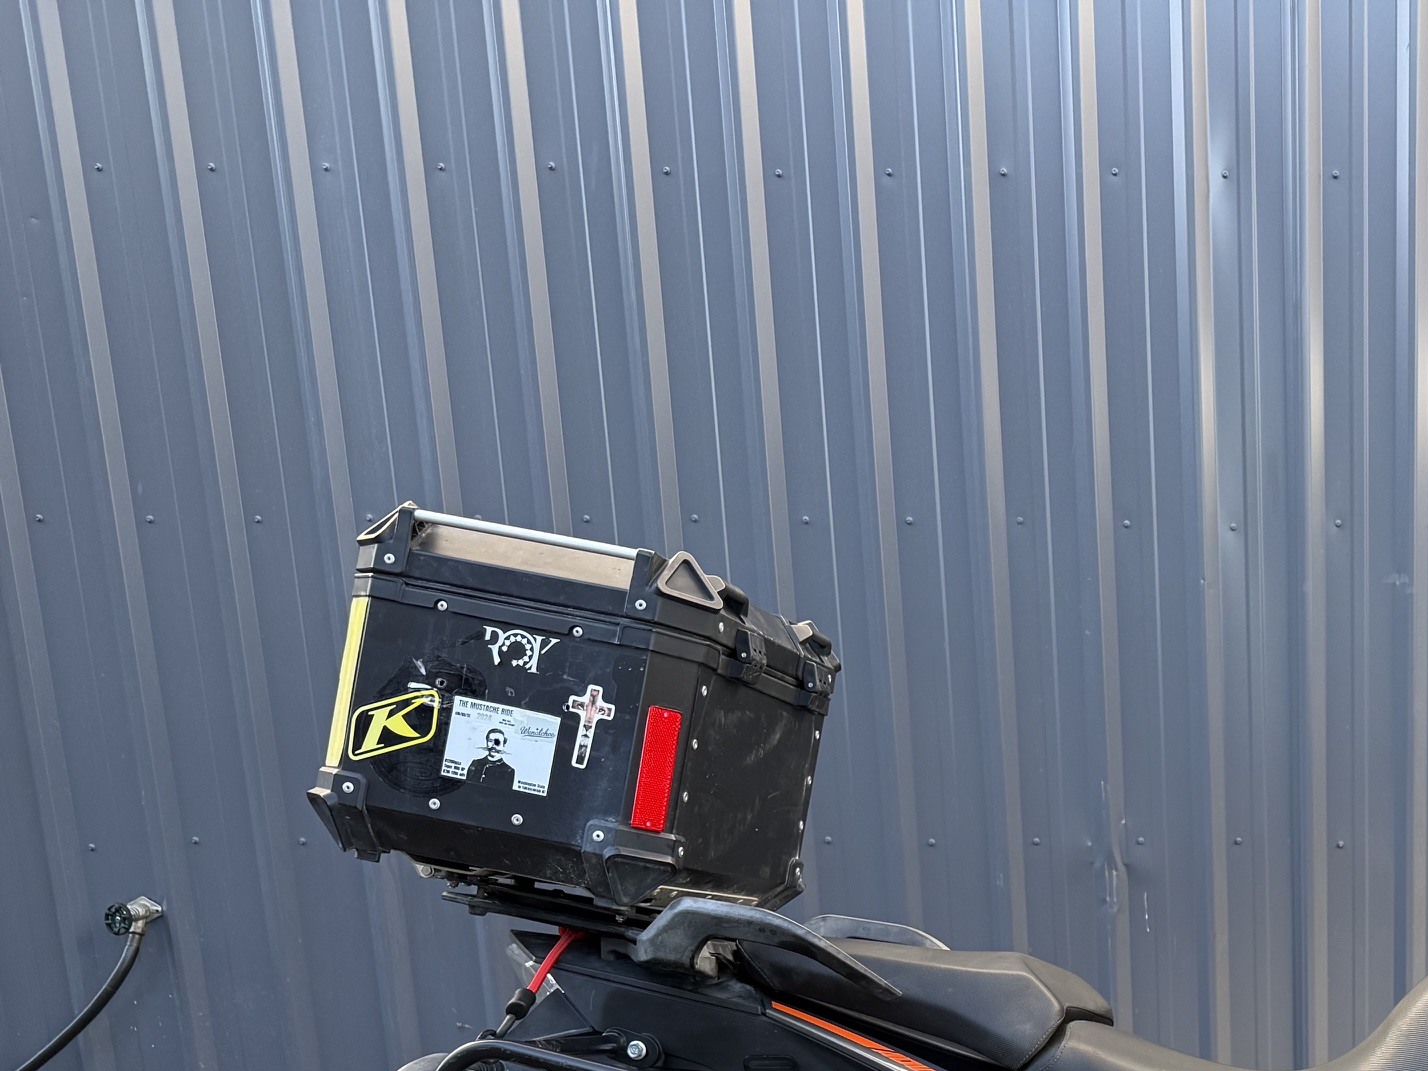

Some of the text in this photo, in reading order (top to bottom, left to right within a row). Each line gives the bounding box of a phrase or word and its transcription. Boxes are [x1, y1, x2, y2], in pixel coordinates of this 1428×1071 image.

[459, 699, 469, 708] THE
[470, 703, 500, 715] MUSTACHE
[501, 709, 514, 717] RIDE
